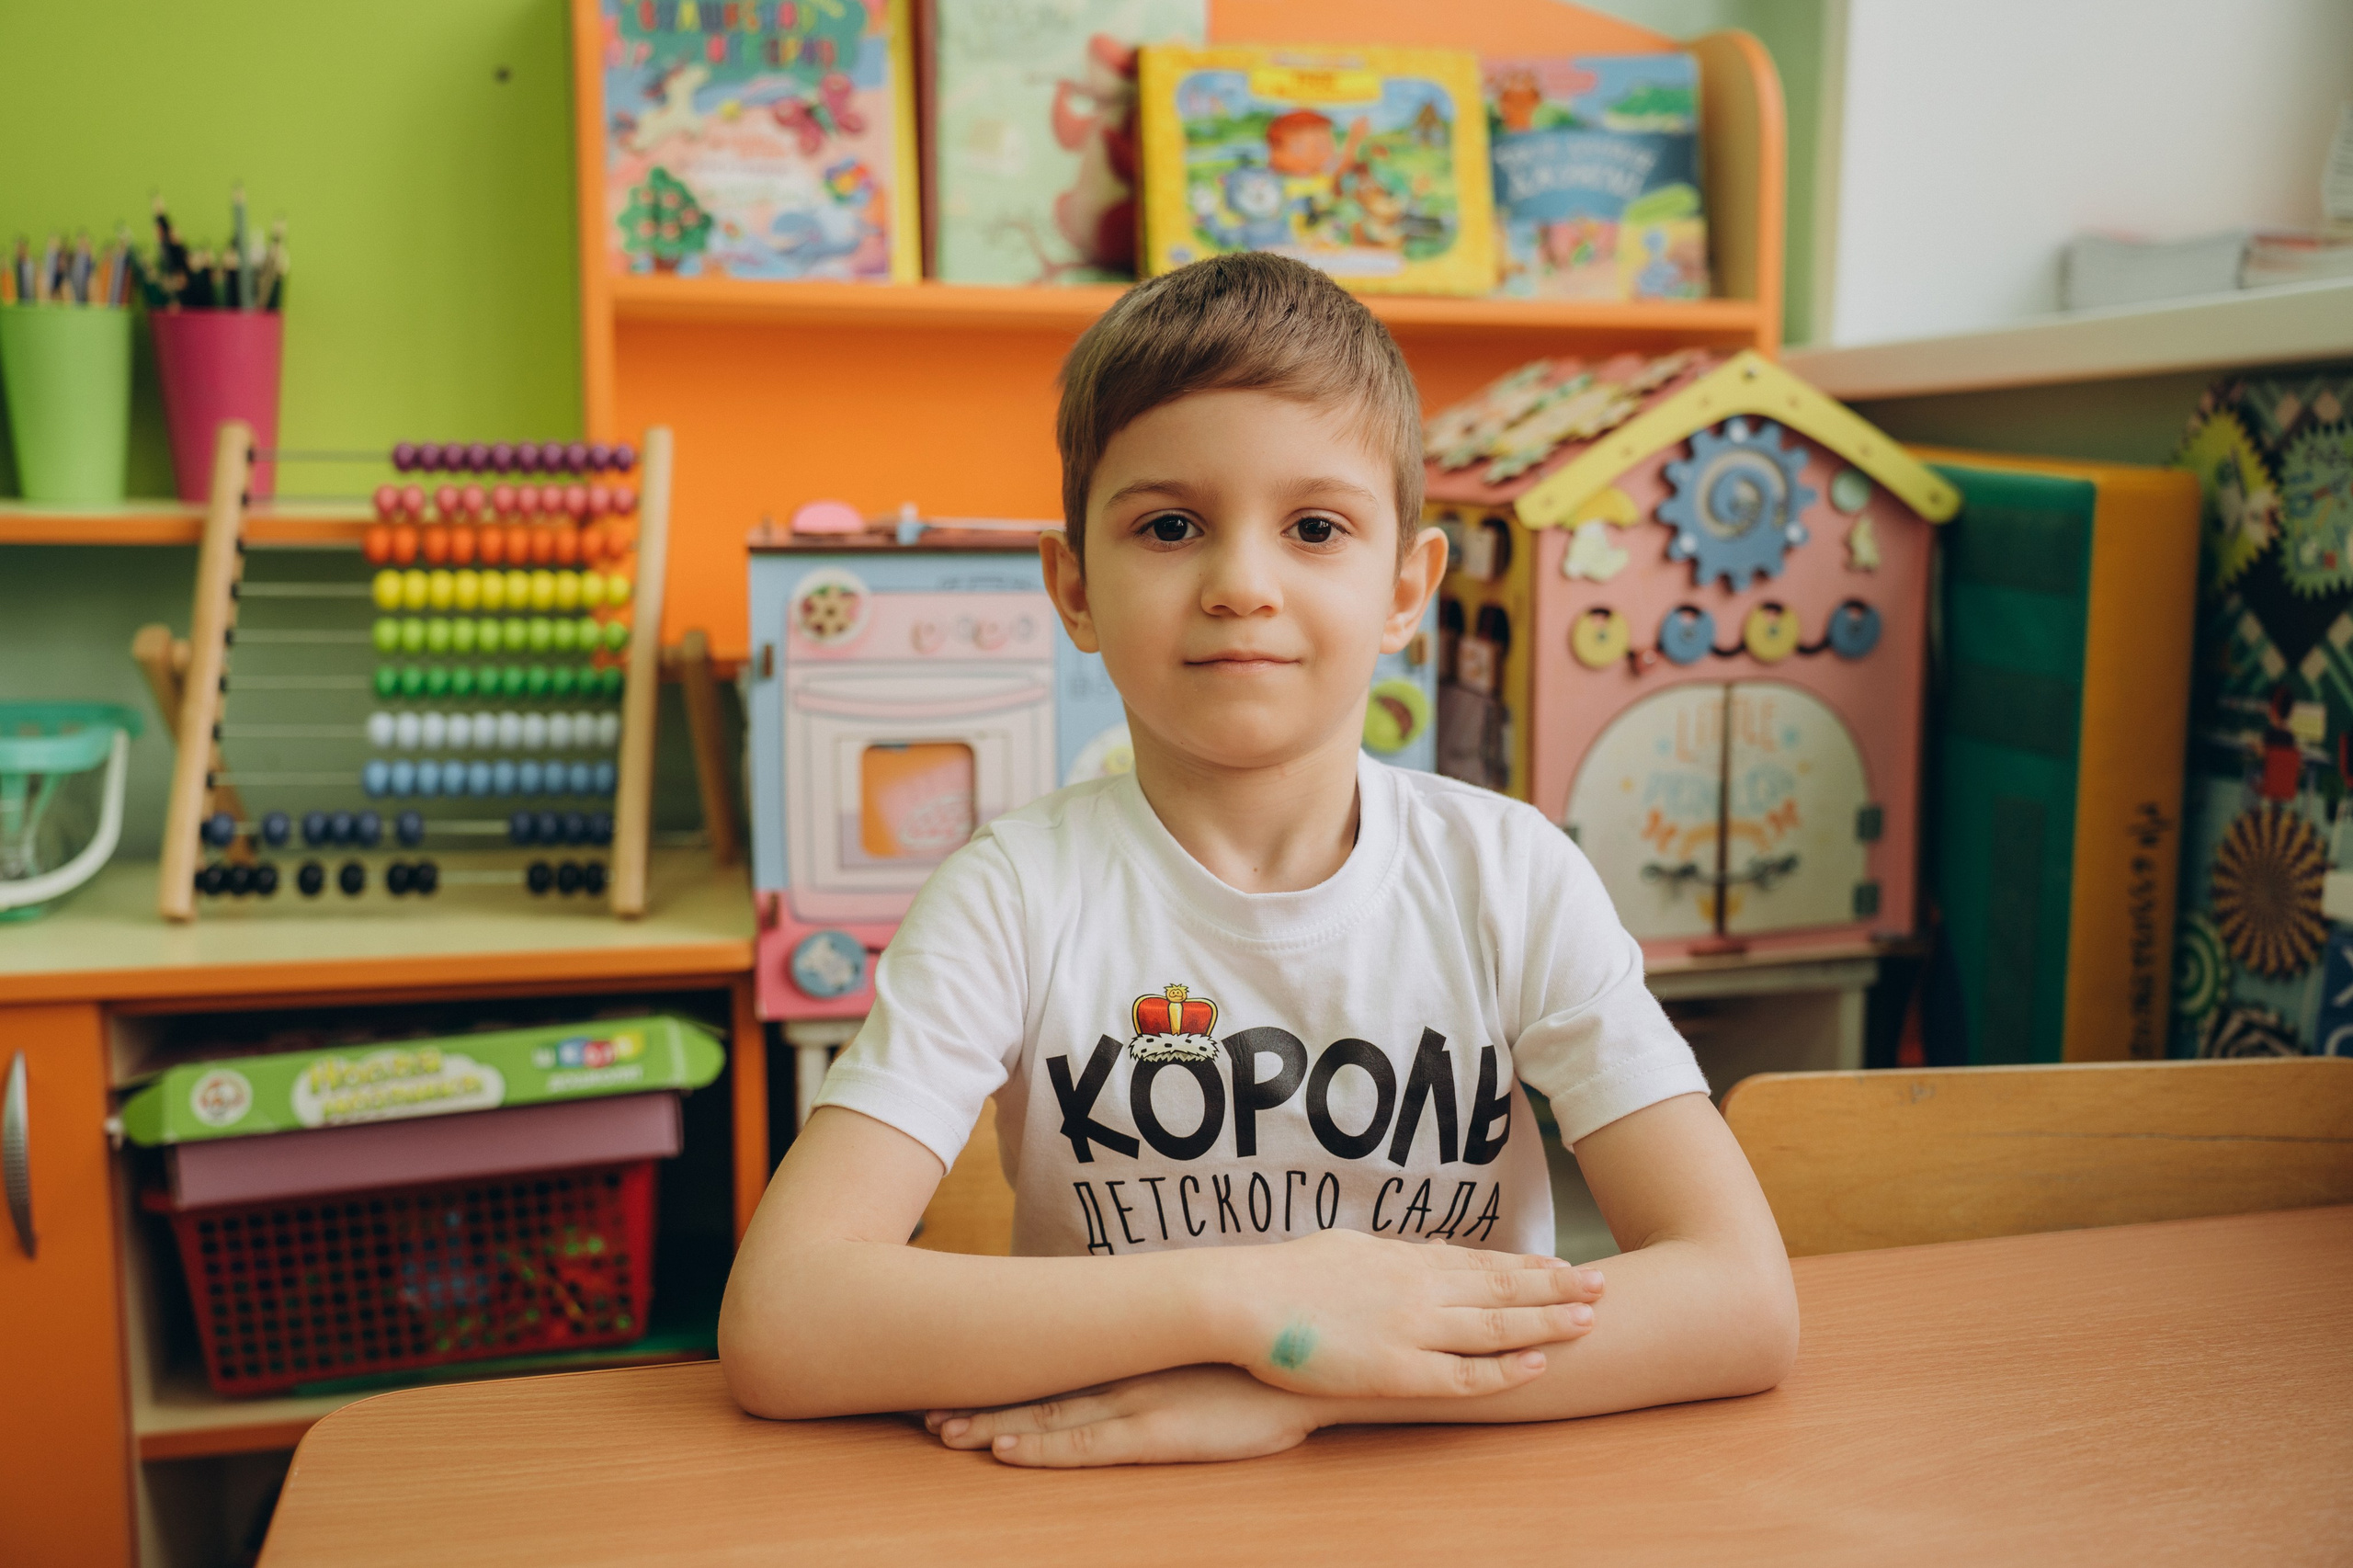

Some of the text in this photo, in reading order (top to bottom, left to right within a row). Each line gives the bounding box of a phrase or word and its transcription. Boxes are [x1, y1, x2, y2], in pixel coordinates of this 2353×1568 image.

[1045, 1026, 1512, 1167] КОРОЛЬ
[1073, 1170, 1501, 1256] ДЕТСКОГО САДА
